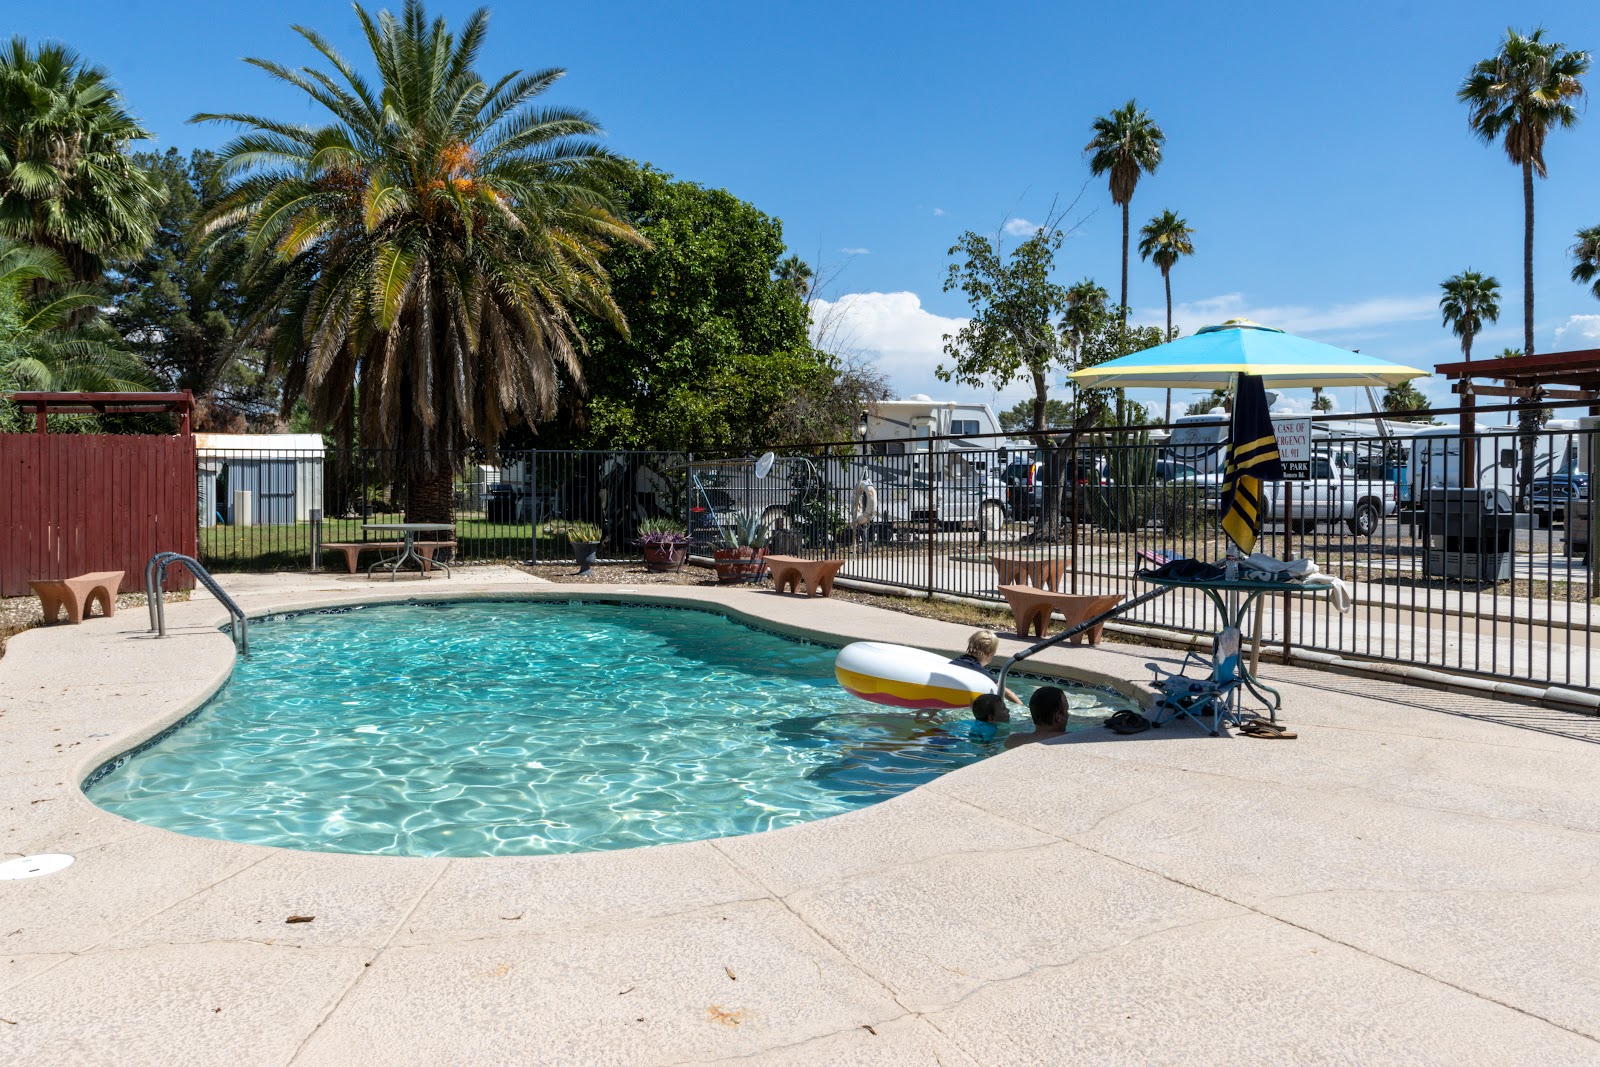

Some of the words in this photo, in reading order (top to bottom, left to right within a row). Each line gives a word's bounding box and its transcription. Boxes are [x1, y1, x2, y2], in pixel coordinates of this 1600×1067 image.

[1278, 424, 1294, 433] CASE
[1296, 423, 1305, 432] OF
[1277, 436, 1306, 445] ERGENCY
[1281, 449, 1289, 458] AL
[1290, 448, 1299, 458] 911
[1281, 463, 1288, 471] V
[1289, 463, 1308, 471] PARK
